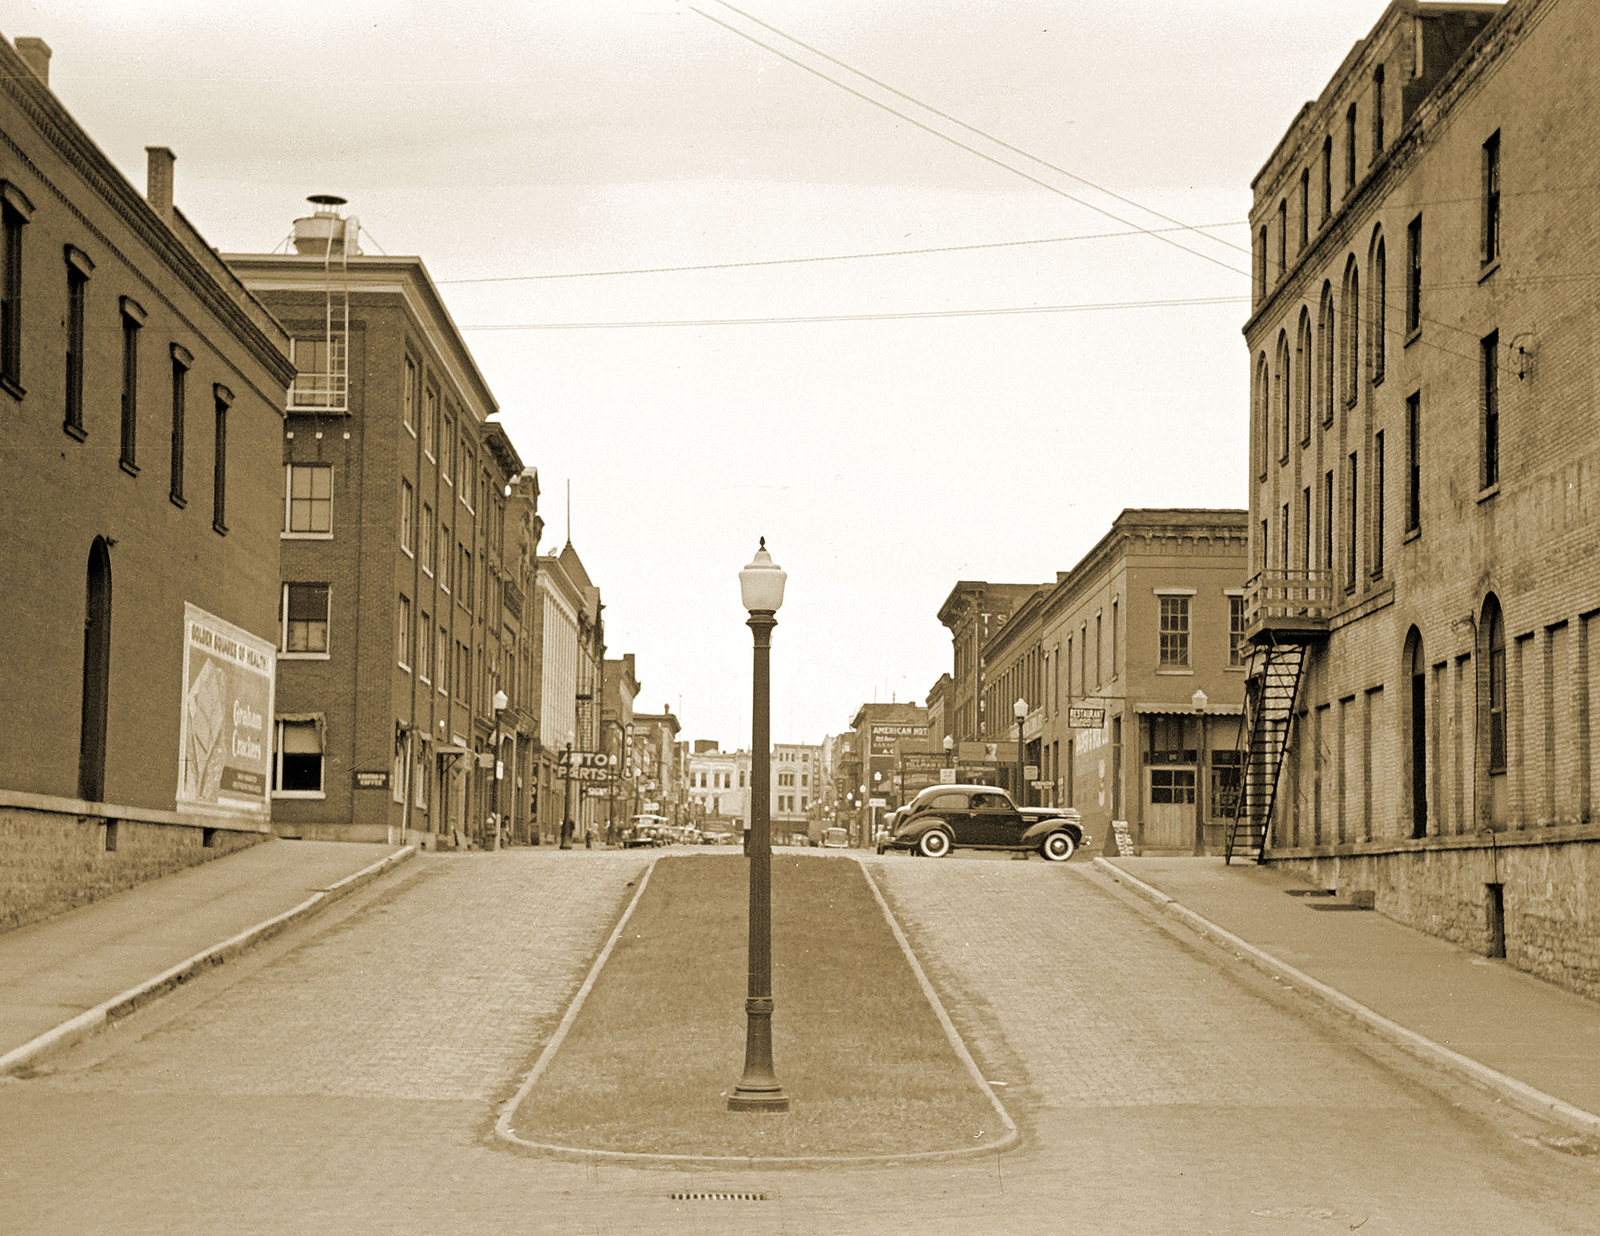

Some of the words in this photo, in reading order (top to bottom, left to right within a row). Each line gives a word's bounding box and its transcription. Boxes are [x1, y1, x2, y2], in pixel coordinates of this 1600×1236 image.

[233, 700, 262, 730] Graham
[1070, 709, 1105, 718] RESTAURANT
[873, 726, 912, 735] AMERICAN
[232, 729, 261, 760] Crackers
[558, 766, 608, 780] PARTS
